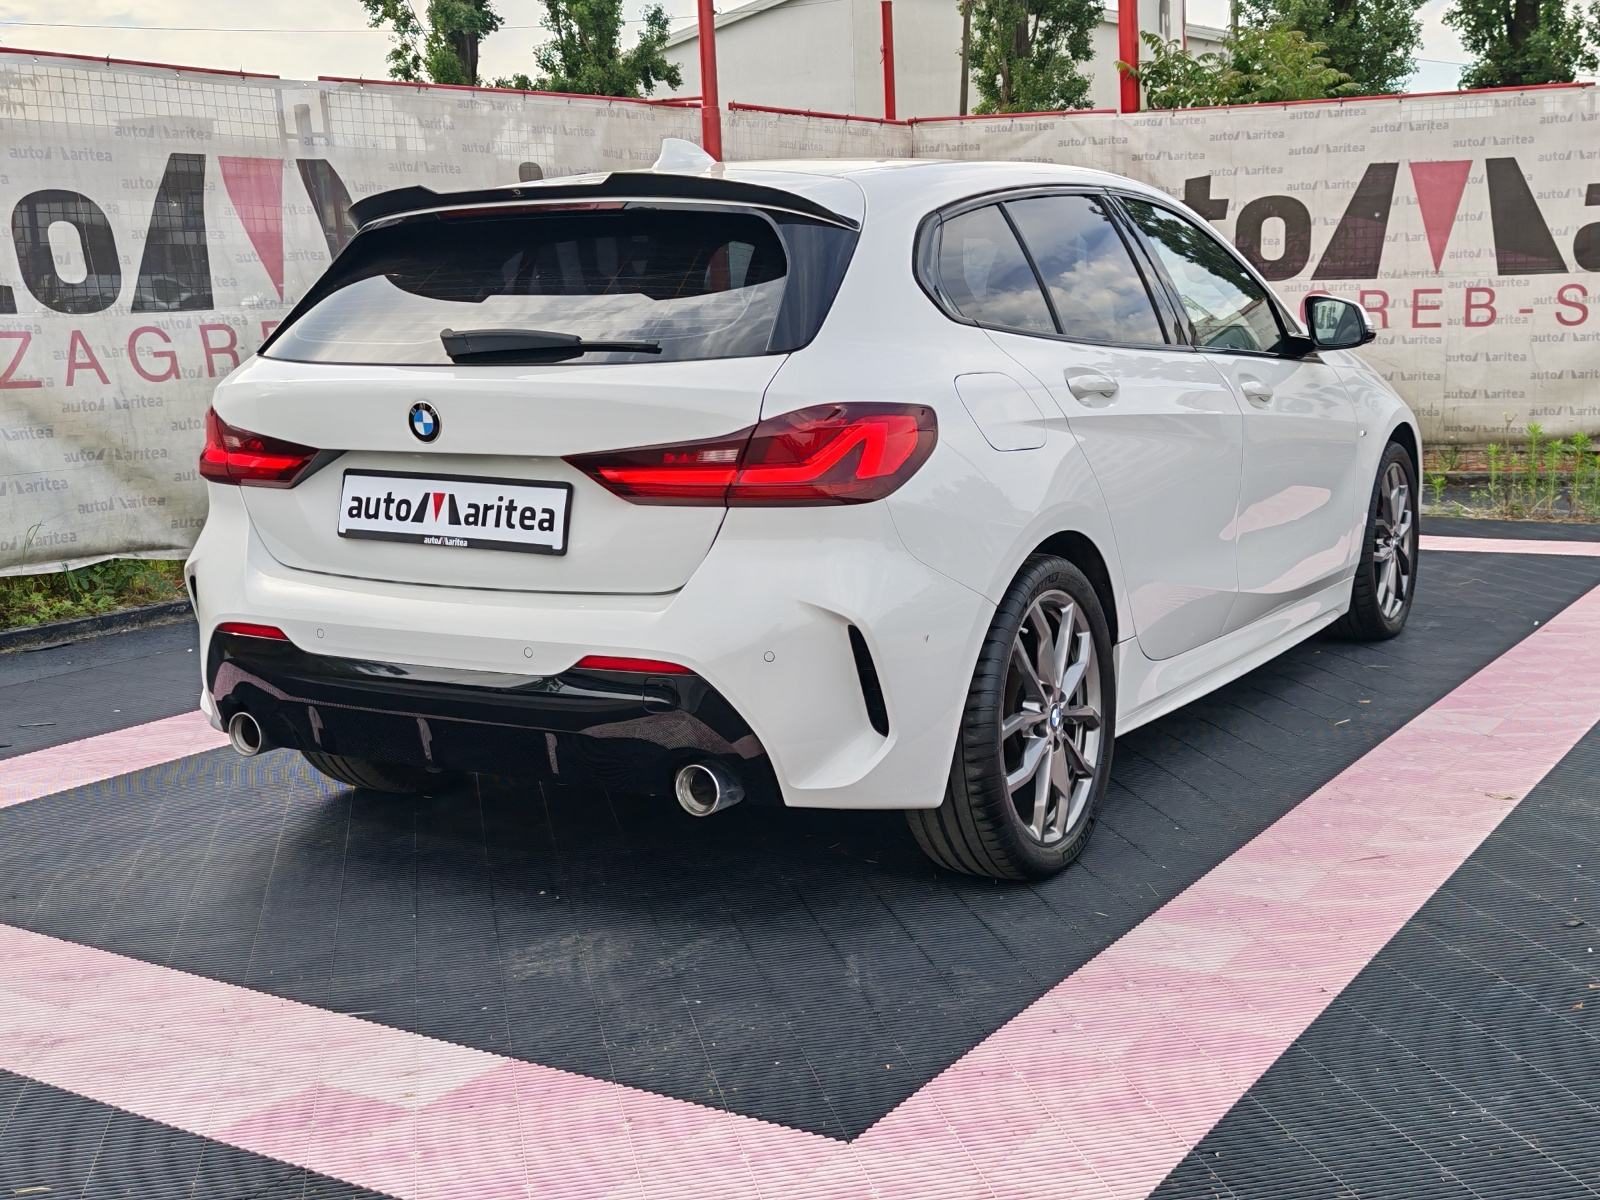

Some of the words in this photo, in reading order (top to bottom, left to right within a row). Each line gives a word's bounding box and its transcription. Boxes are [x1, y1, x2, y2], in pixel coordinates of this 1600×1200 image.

[1286, 179, 1358, 192] autoMarite
[0, 320, 281, 390] ZAGR
[347, 491, 555, 532] autoMaritea
